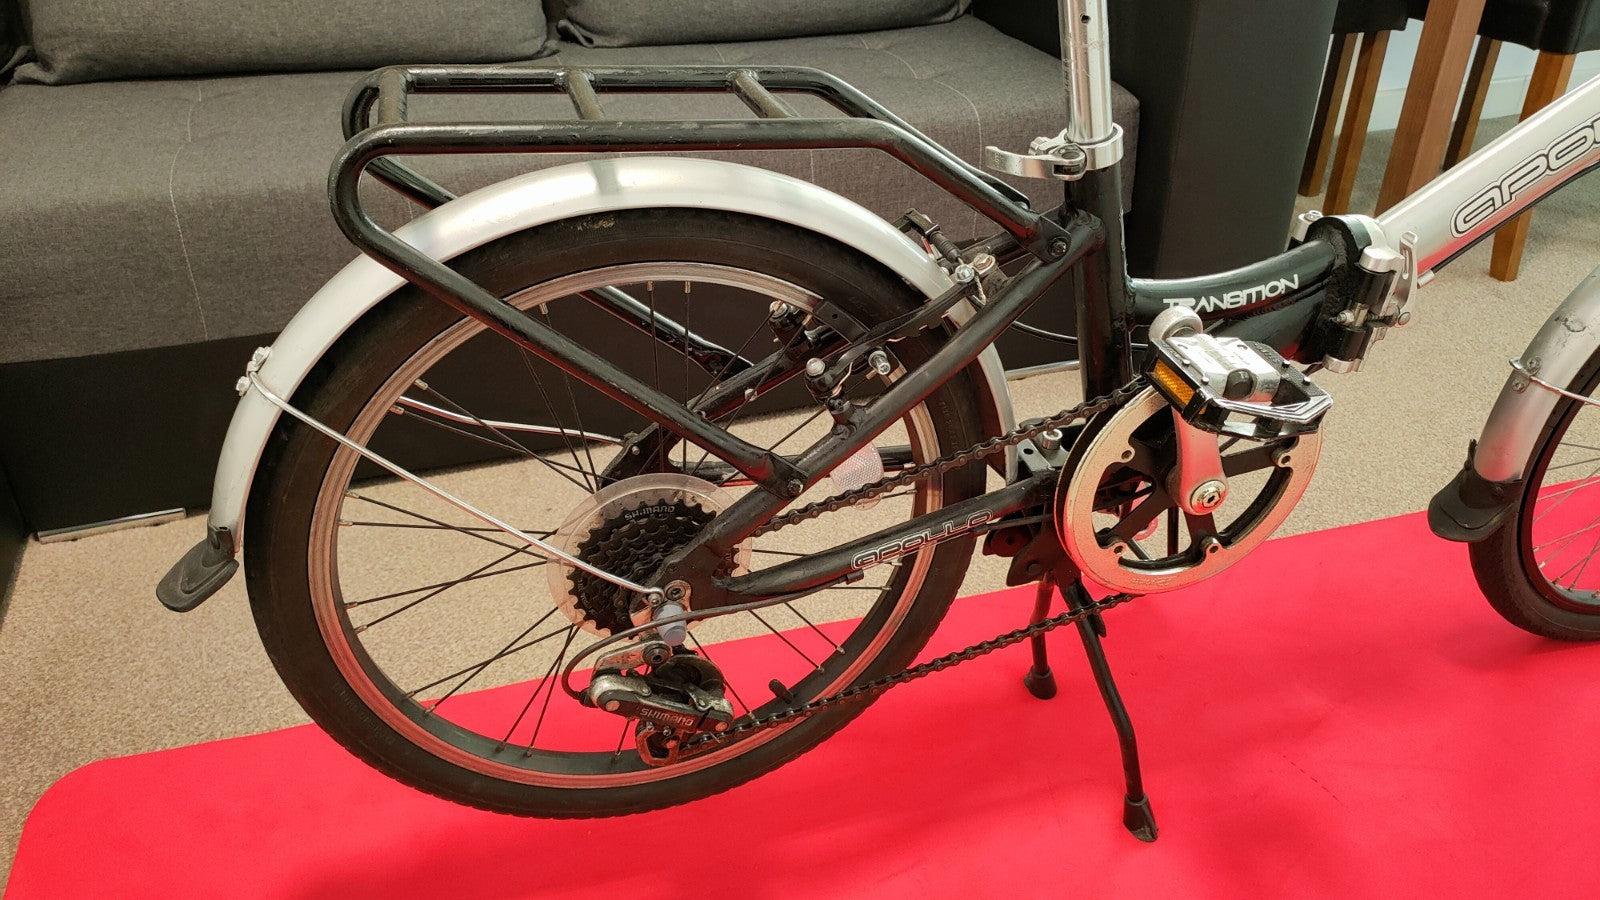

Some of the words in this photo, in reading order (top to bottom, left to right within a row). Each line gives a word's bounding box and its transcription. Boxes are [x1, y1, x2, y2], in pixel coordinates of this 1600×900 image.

[1162, 273, 1300, 313] TRANSITION
[624, 505, 676, 521] SHIMANO
[850, 508, 994, 572] APOLLO
[639, 706, 695, 728] SHIMANO
